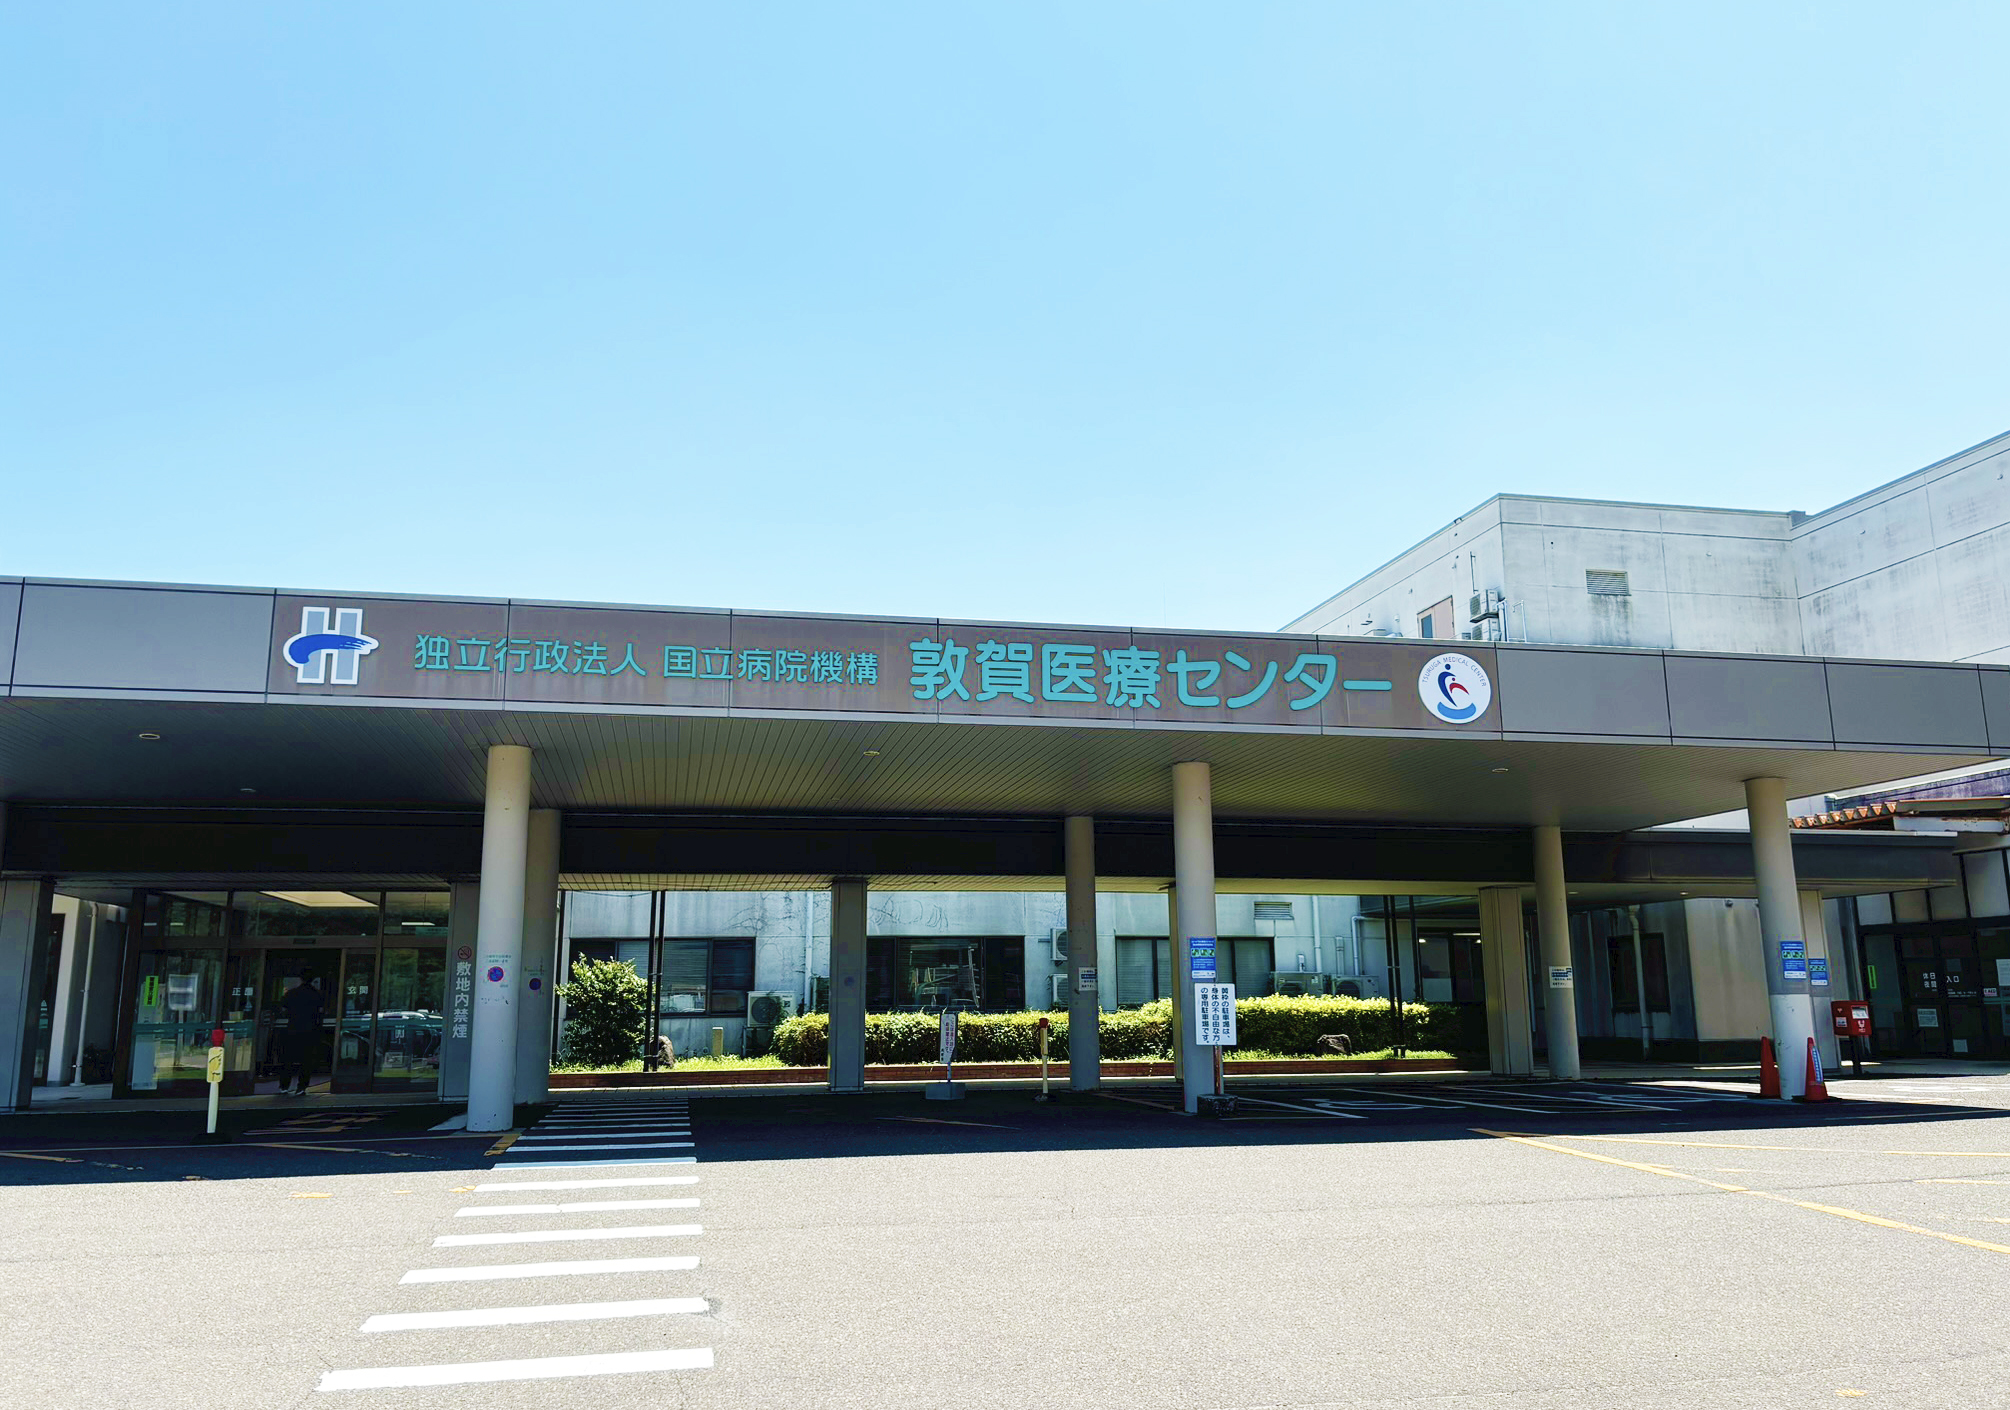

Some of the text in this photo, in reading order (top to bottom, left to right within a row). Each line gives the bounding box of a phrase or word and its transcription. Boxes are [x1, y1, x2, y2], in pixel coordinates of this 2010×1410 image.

[414, 634, 879, 685] 独立行政法人 国立病院機構
[909, 637, 1392, 711] 敦賀医療センター
[1422, 656, 1487, 687] TSURUGA MEDICAL CENTER
[347, 985, 369, 995] 玄関
[1946, 975, 1960, 983] 入口
[452, 961, 471, 1039] 敷地内禁煙
